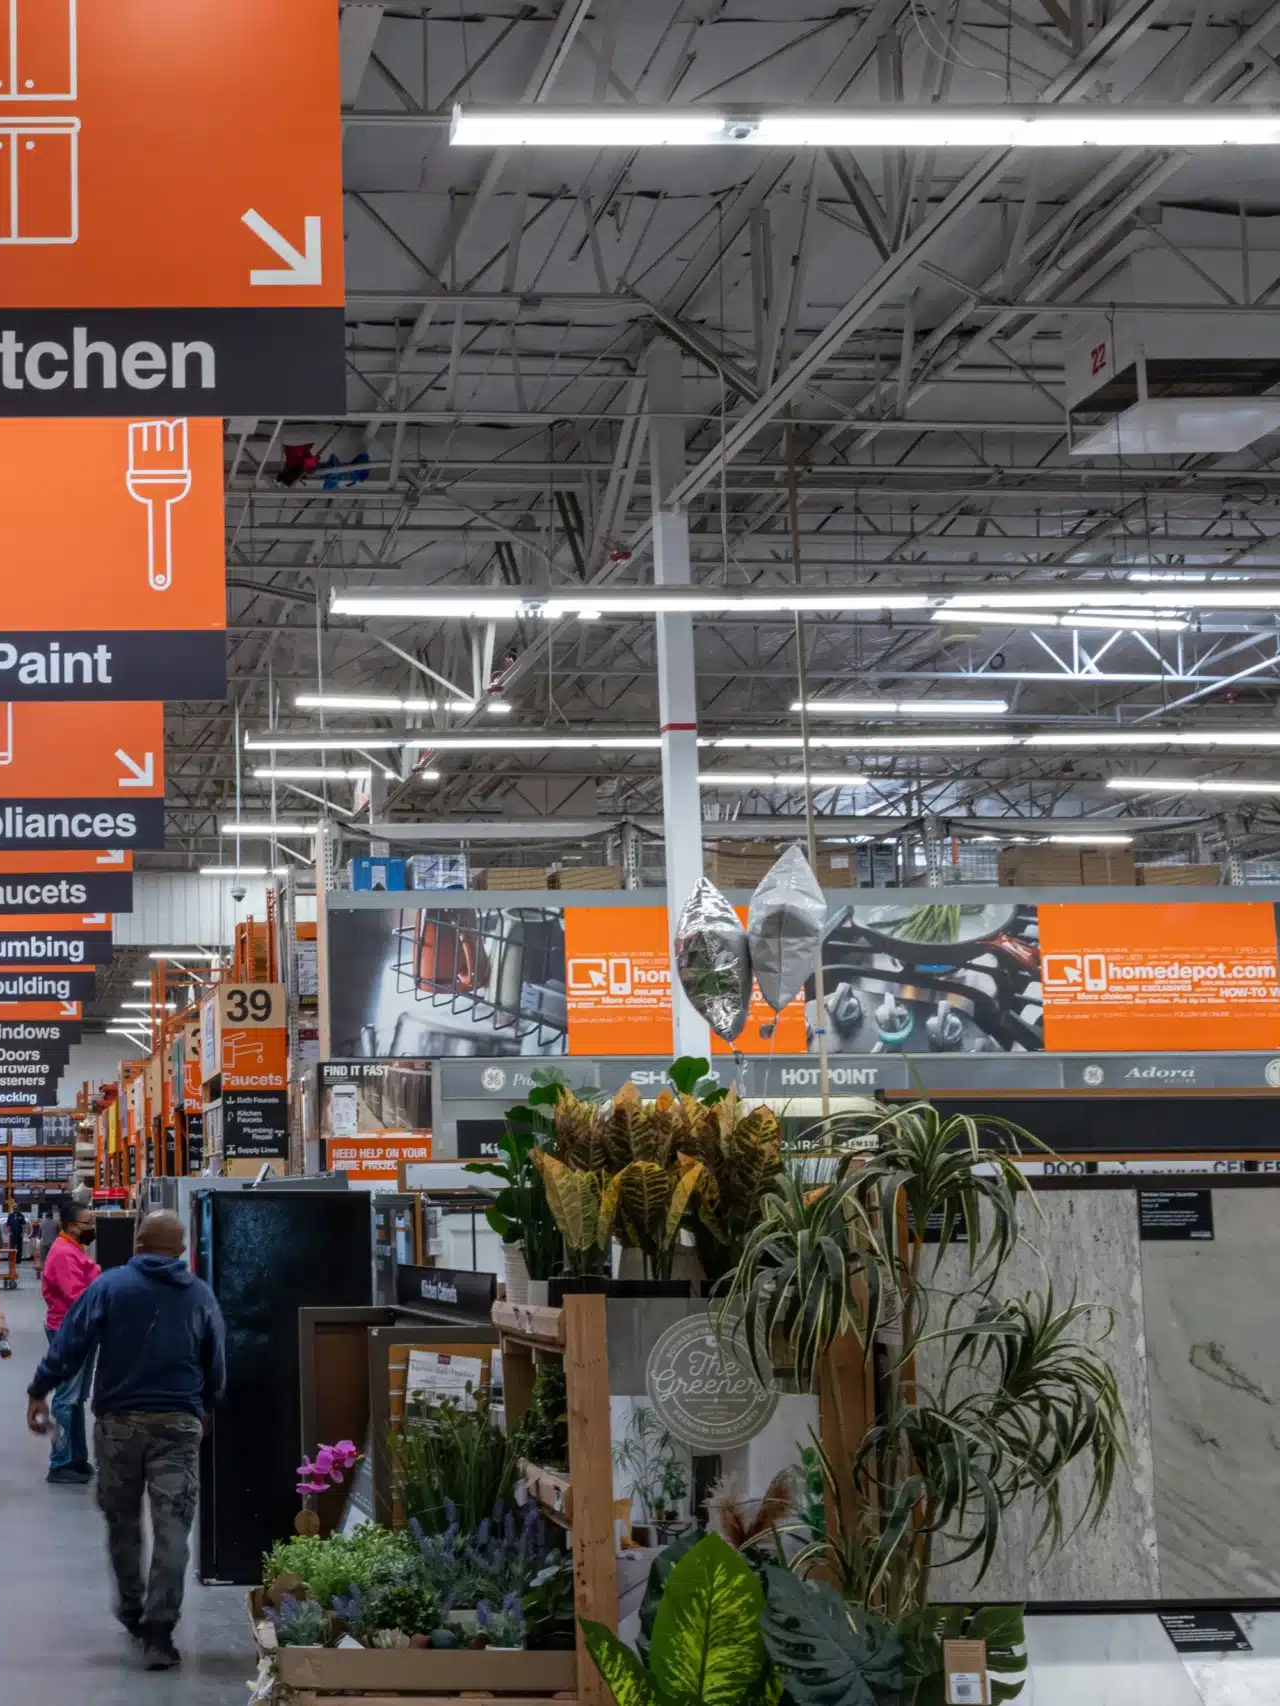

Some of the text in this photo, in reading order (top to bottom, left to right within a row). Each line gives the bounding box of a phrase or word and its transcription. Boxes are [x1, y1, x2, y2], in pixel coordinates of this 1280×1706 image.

[1090, 342, 1106, 377] 22
[1108, 962, 1276, 983] homedepot.com
[1219, 987, 1266, 998] HOW-TO
[226, 988, 272, 1022] 39
[323, 1065, 389, 1077] FIND IT FAST
[1123, 1066, 1196, 1079] Adora
[222, 1072, 284, 1087] Faucets
[243, 1127, 274, 1135] Plumbing
[252, 1134, 274, 1142] Repair
[236, 1147, 260, 1155] Supply
[332, 1147, 428, 1159] NEED HELP ON YOUR
[688, 1350, 740, 1377] The
[651, 1368, 778, 1403] Greenery
